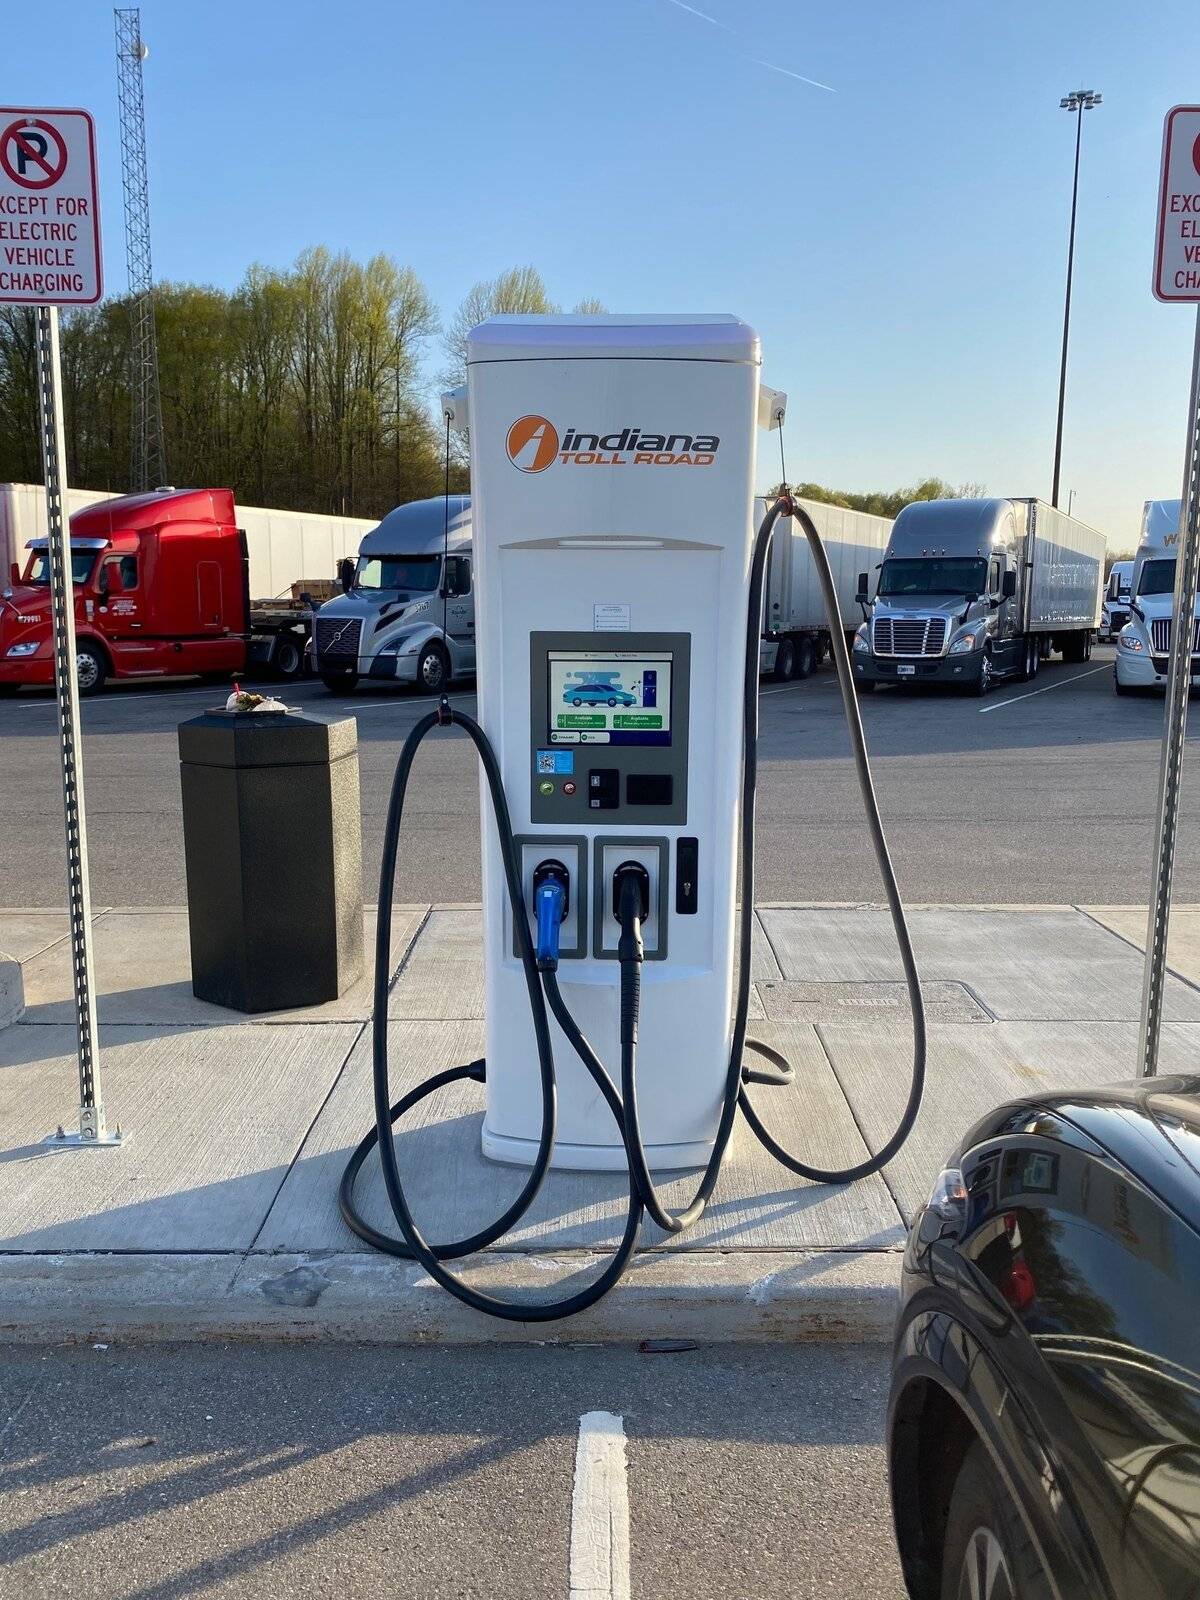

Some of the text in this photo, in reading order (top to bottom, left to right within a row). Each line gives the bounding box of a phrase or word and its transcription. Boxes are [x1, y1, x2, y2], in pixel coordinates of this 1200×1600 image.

[56, 198, 88, 216] FOR
[0, 222, 77, 241] ELECTRIC
[5, 247, 75, 266] VEHICLE
[0, 272, 83, 292] CHARGING
[561, 428, 720, 452] indiana
[558, 453, 714, 466] TOLL ROAD
